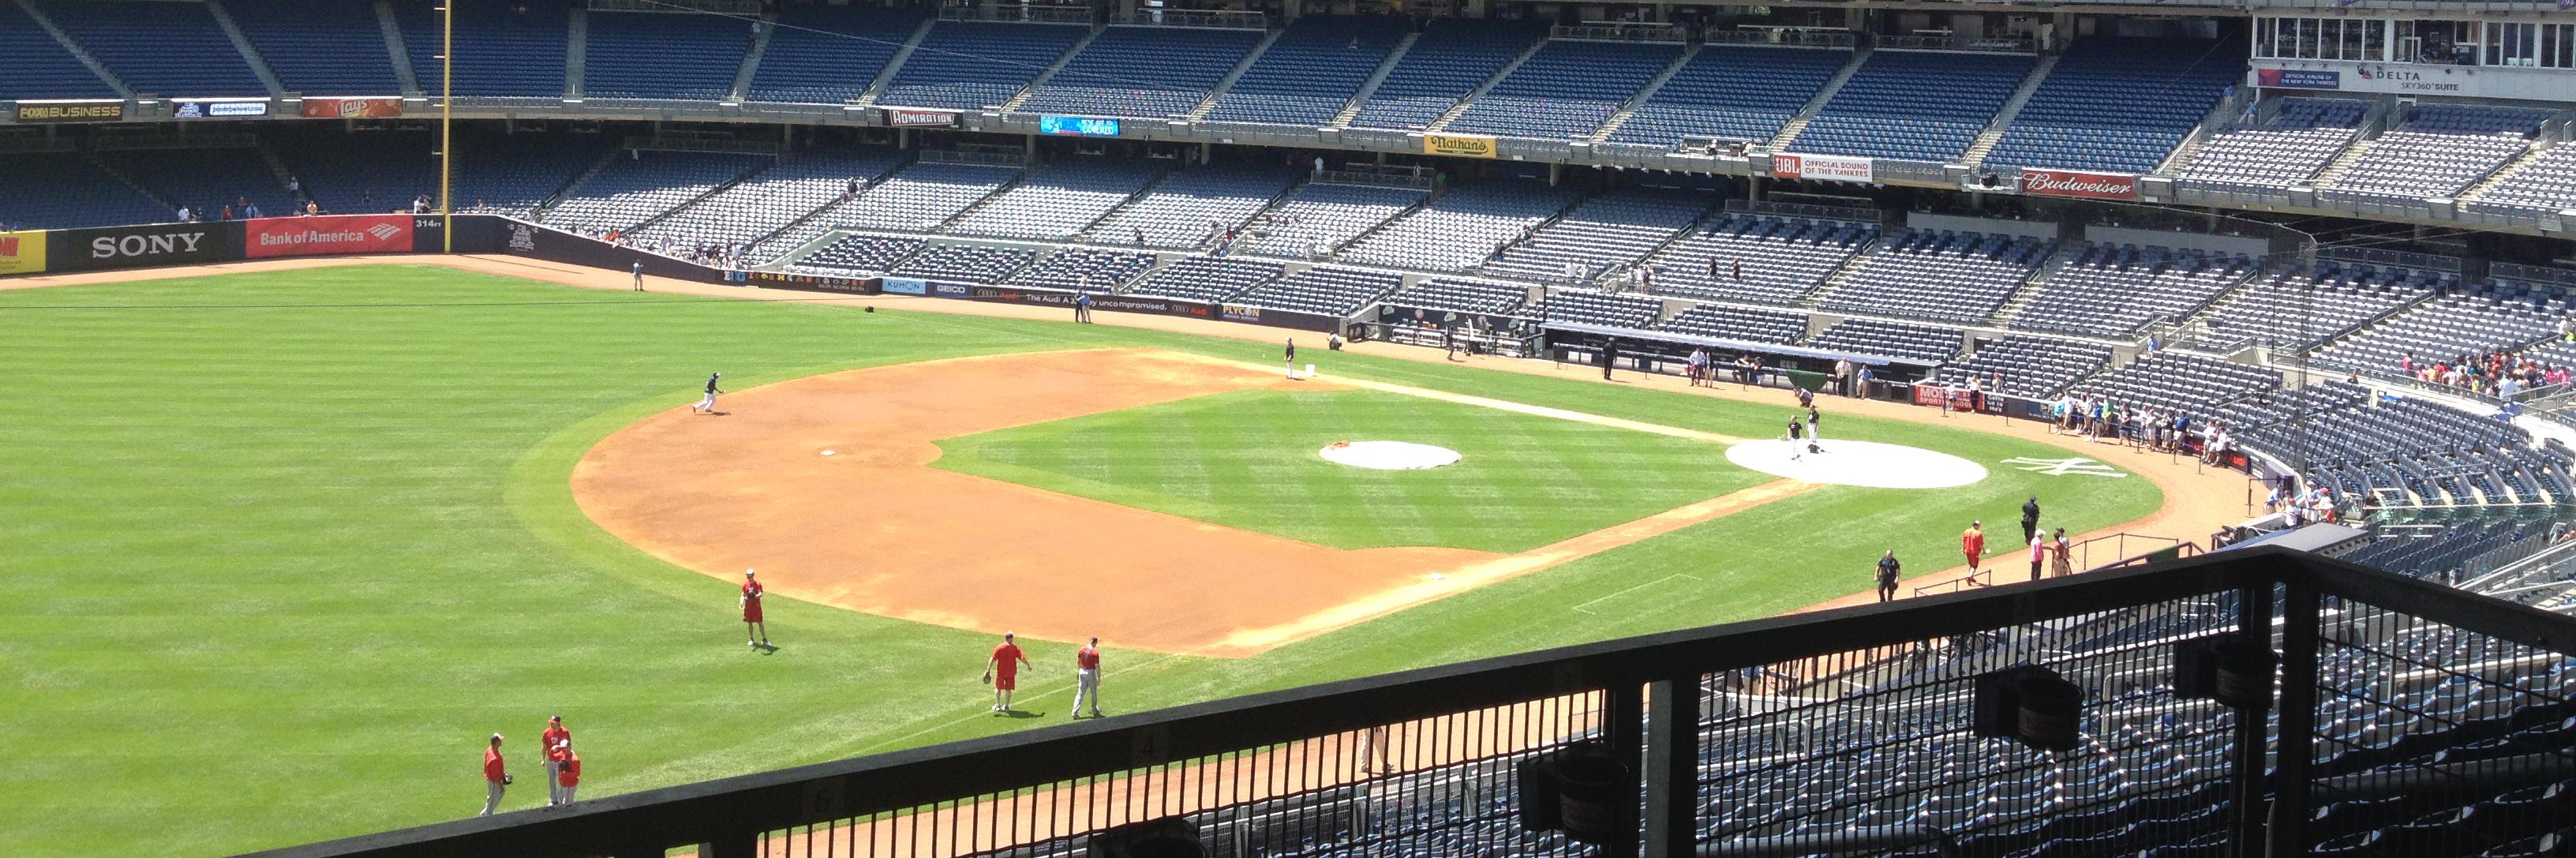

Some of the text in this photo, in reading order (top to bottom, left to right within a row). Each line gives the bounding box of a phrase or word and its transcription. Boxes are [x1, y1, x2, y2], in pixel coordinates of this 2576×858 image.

[2376, 71, 2420, 81] DELTA
[20, 106, 121, 118] FOX BUSINESS
[1431, 136, 1487, 151] Nathan's
[1776, 157, 1800, 174] JBL
[1834, 169, 1869, 178] YANKEES
[2023, 173, 2132, 194] Budweiser
[260, 230, 364, 245] Bank of America
[92, 232, 205, 259] SONY
[887, 281, 919, 290] KUMON
[937, 285, 965, 294] GEICO
[1099, 300, 1167, 309] uncompromised.
[1190, 307, 1208, 316] Audi
